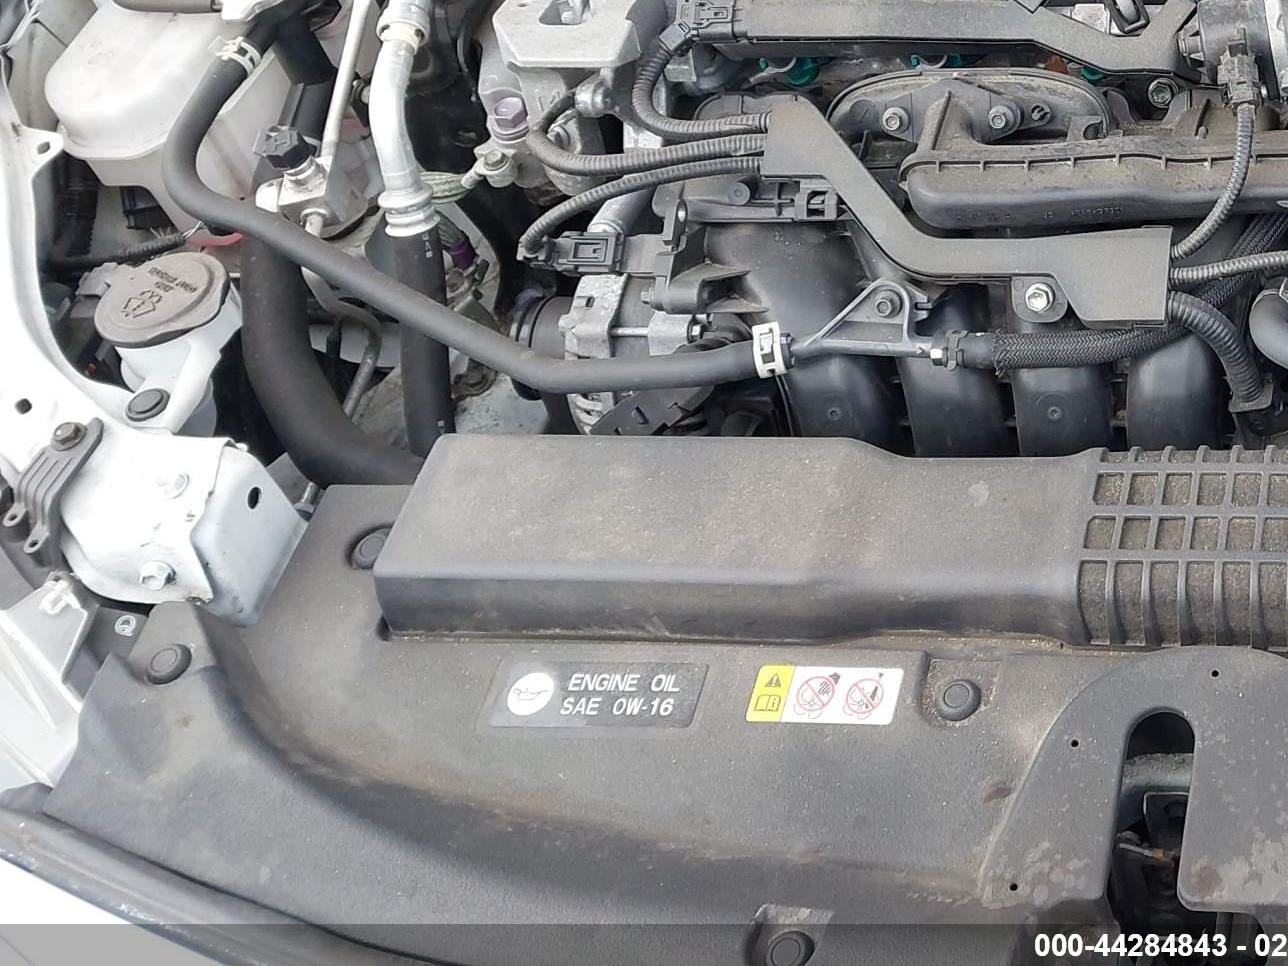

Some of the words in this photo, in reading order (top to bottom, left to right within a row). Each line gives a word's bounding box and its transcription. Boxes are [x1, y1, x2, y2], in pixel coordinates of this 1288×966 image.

[568, 673, 641, 692] ENGINE
[651, 673, 680, 692] OIL
[559, 697, 602, 716] SAE
[612, 697, 674, 716] 0W-16
